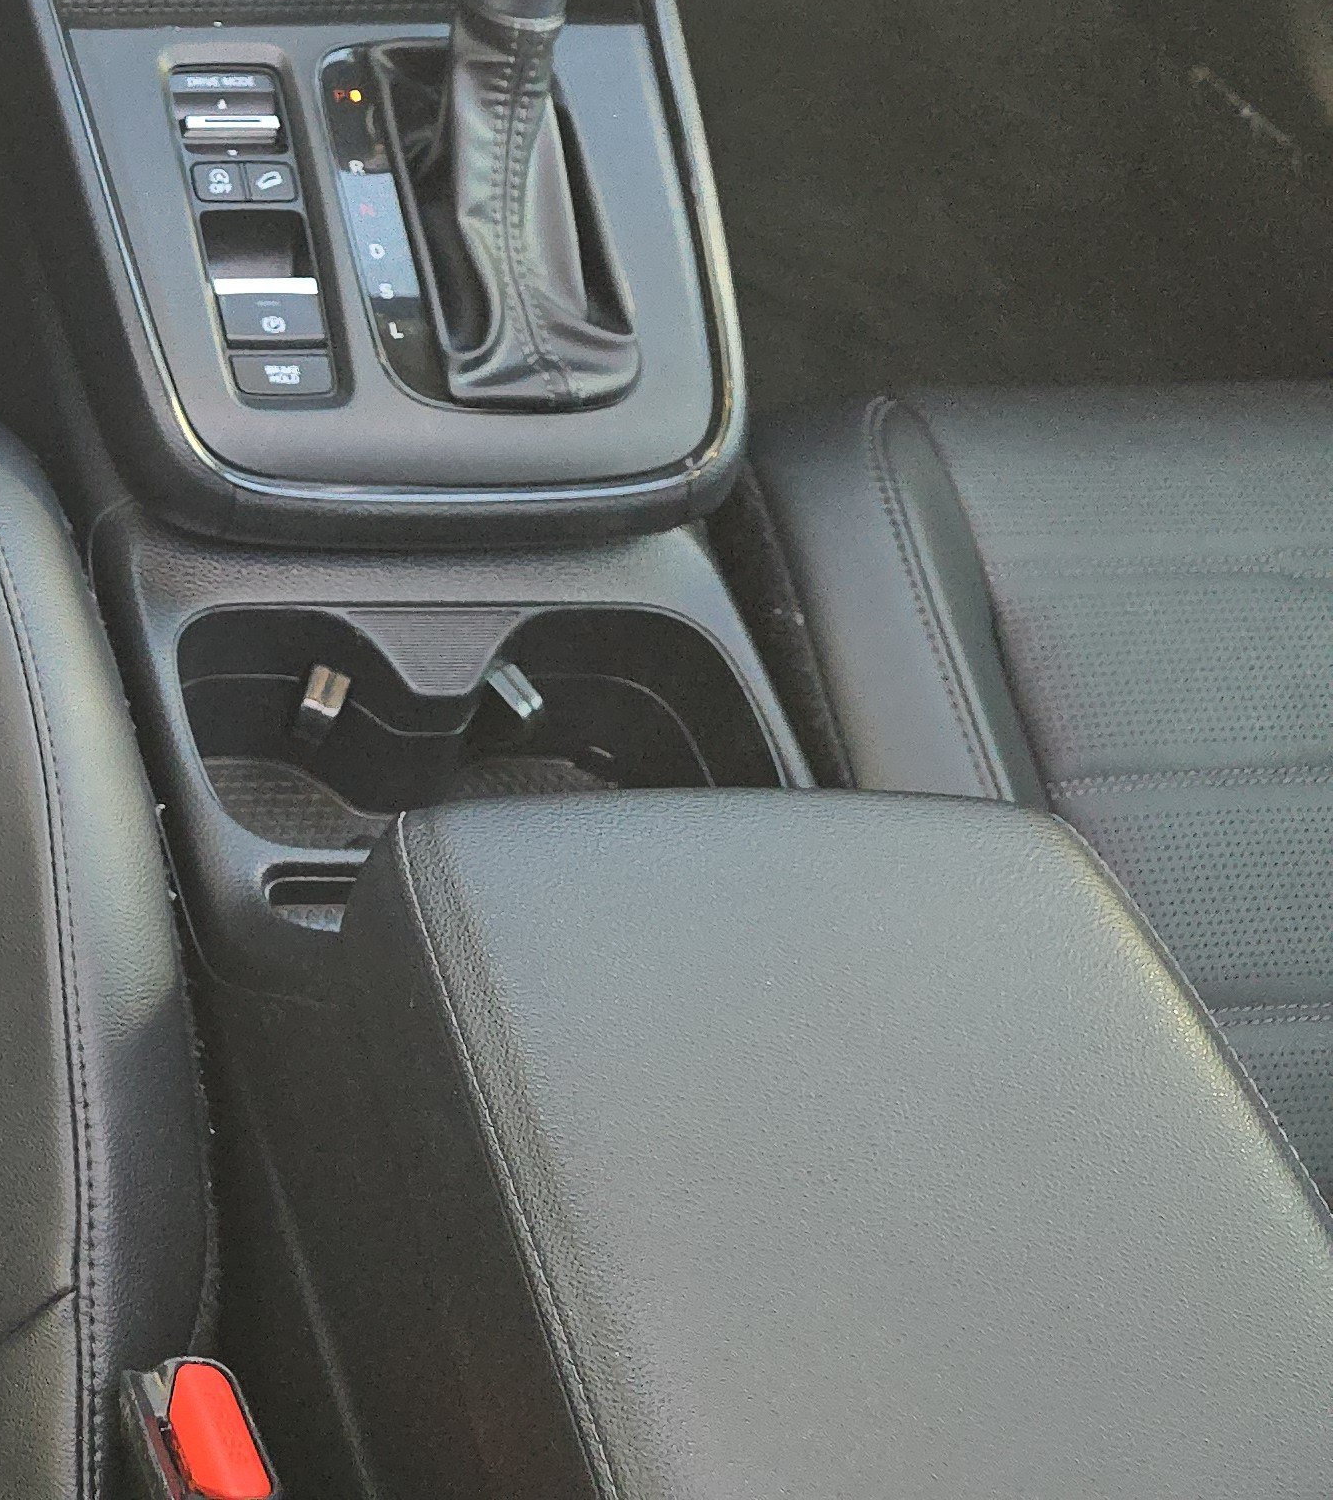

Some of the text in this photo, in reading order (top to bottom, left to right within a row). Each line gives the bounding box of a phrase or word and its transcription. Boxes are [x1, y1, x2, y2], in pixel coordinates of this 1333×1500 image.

[349, 160, 365, 175] R
[379, 282, 394, 299] S
[388, 321, 404, 340] L
